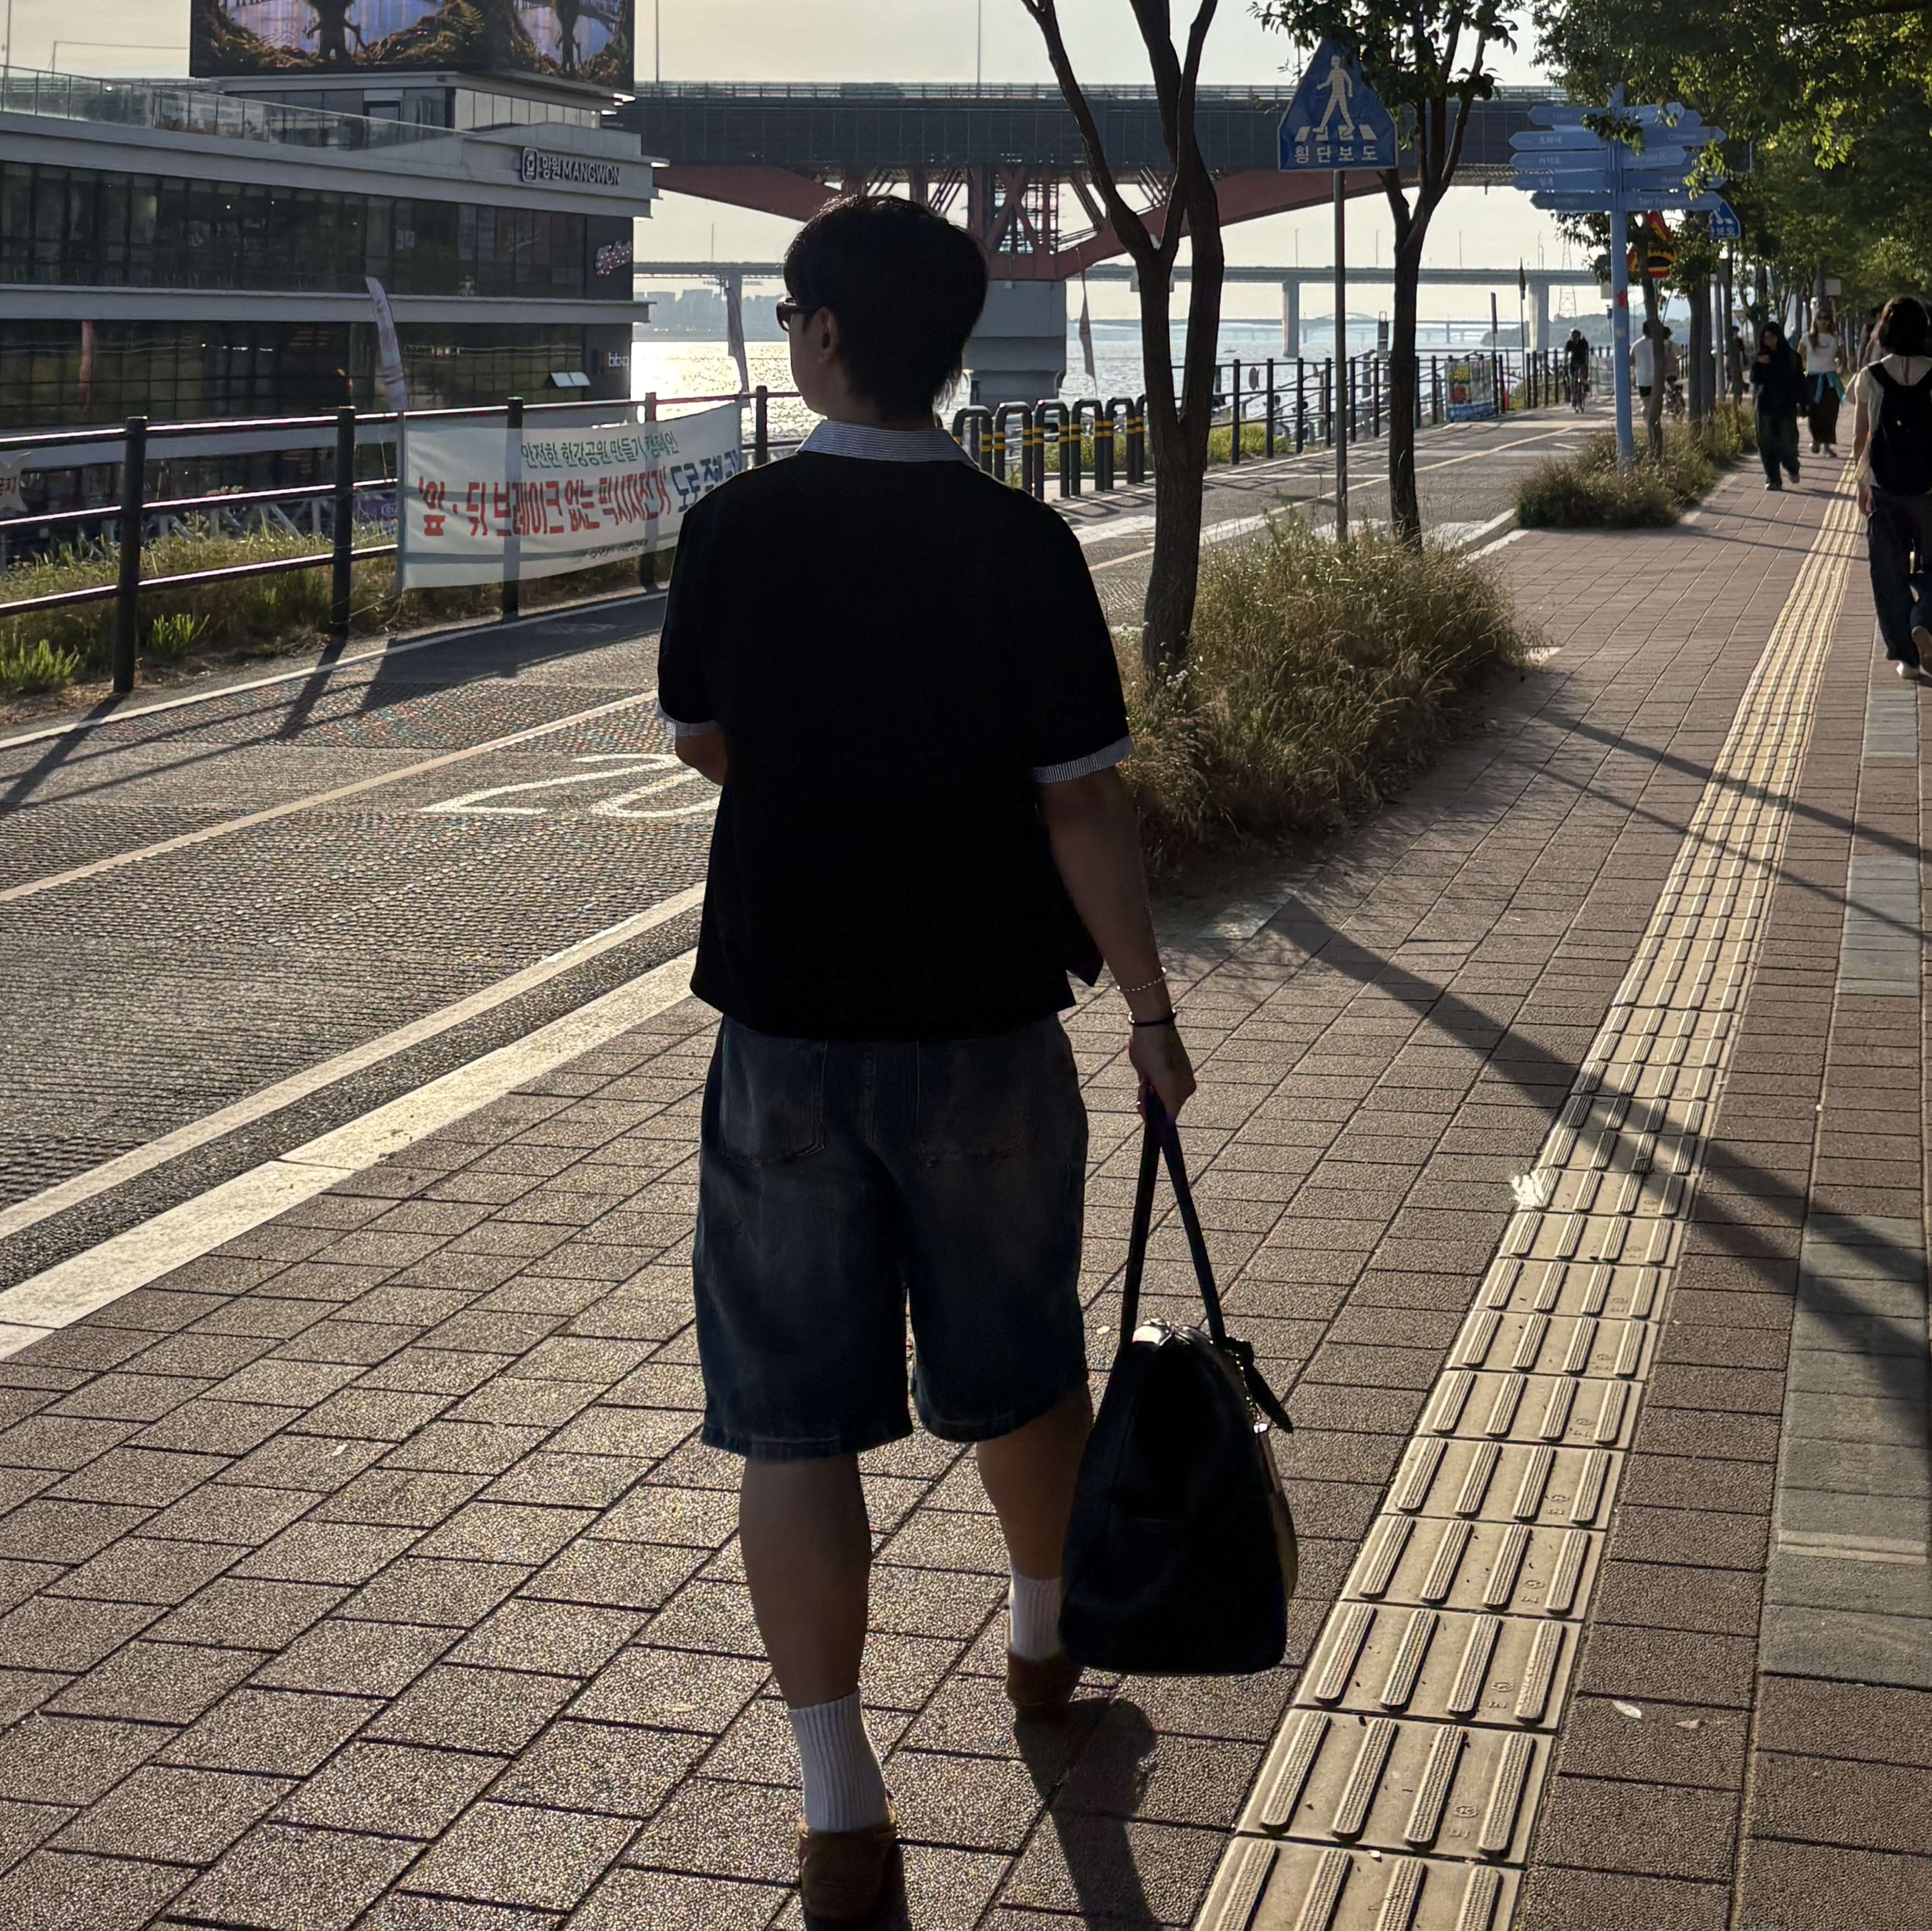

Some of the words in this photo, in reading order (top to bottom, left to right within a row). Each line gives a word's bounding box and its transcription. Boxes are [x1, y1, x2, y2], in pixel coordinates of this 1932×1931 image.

[541, 156, 561, 180] 망원
[561, 158, 621, 186] MANGWON
[1294, 145, 1379, 164] 횡단보도
[521, 442, 563, 469] 안전한
[560, 439, 612, 468] 한강공원
[610, 435, 648, 463] 만들기
[643, 430, 680, 458] 캠페인
[493, 480, 565, 537] 브레이크
[564, 478, 601, 532] 없는
[669, 462, 701, 513] 도로
